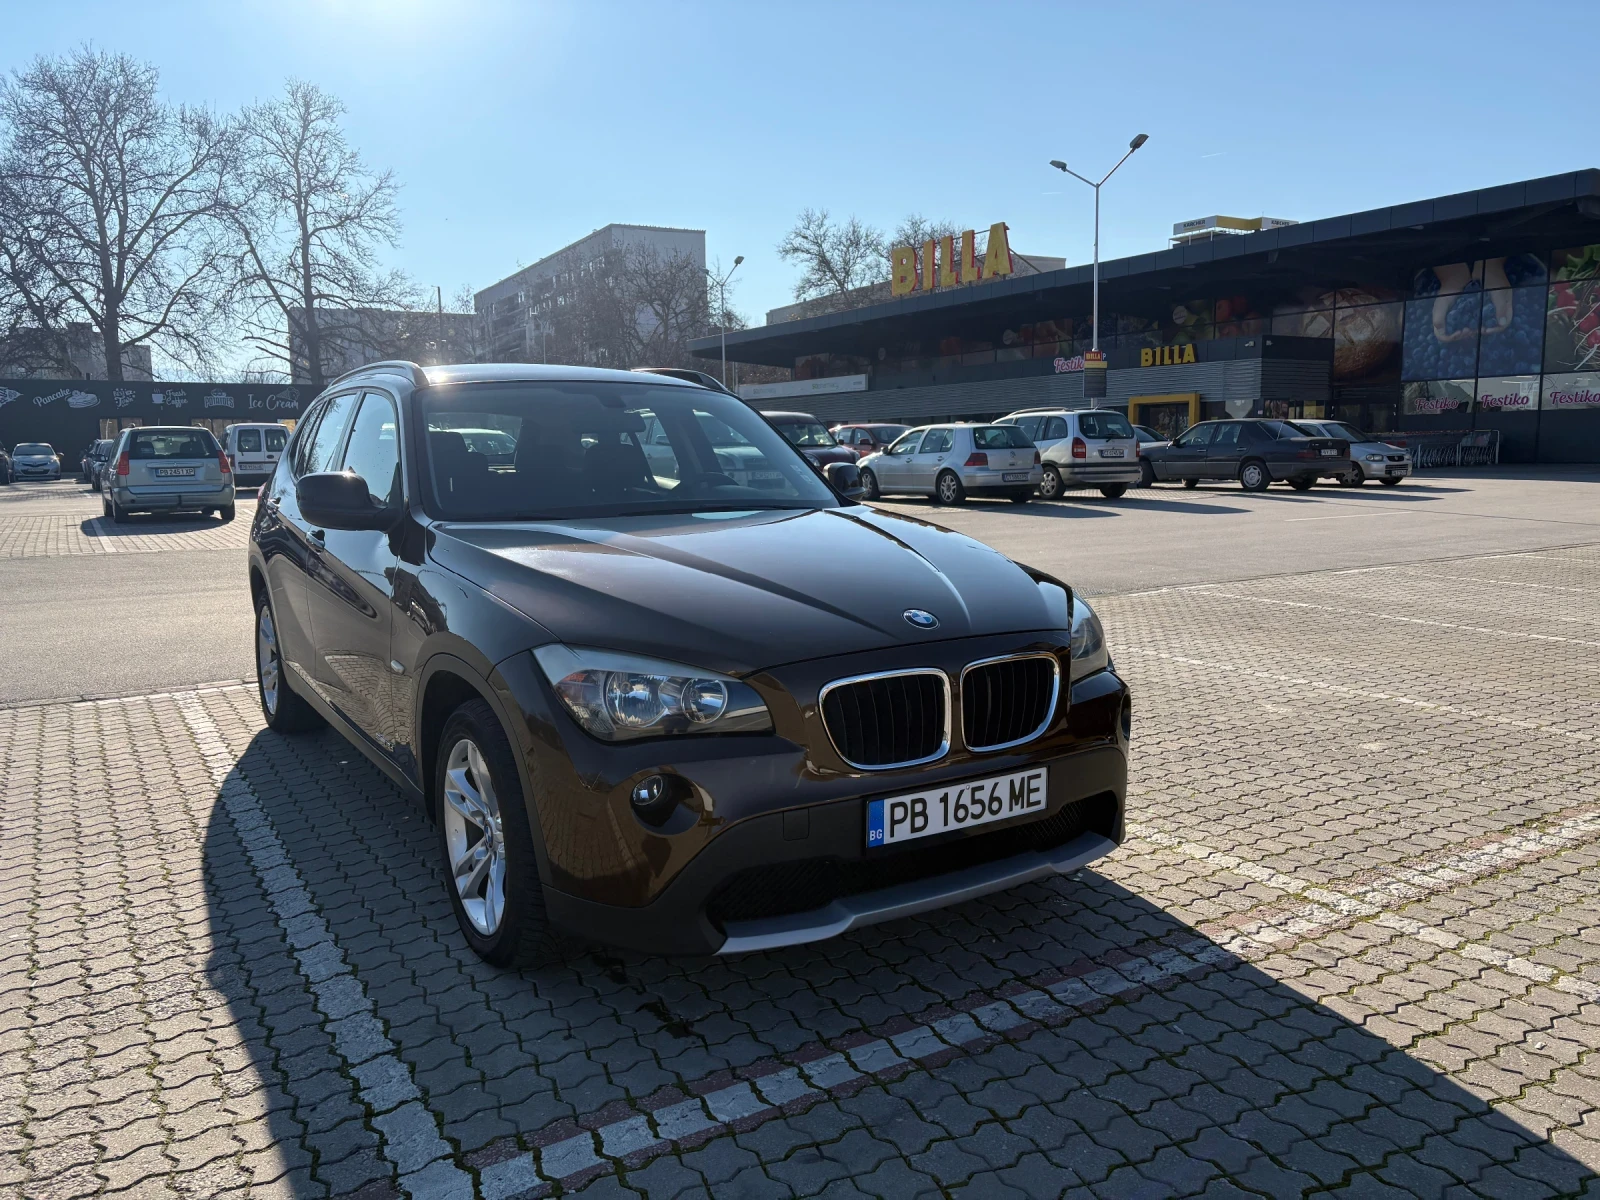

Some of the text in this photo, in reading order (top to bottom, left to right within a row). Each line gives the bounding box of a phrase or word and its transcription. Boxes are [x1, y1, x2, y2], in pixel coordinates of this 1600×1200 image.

[891, 221, 1014, 297] BILLA
[1102, 352, 1107, 360] P
[1140, 343, 1196, 367] BILLA
[1053, 356, 1084, 373] Festik
[32, 387, 72, 407] Pancake
[165, 388, 187, 397] Fresh
[1549, 390, 1600, 405] Festiko
[165, 396, 188, 408] Coffee
[248, 393, 299, 410] Ice Cream
[1415, 397, 1459, 410] Festiko
[1480, 393, 1530, 408] Festiko
[889, 773, 1043, 838] PB 1656 ME
[869, 829, 883, 842] BG
